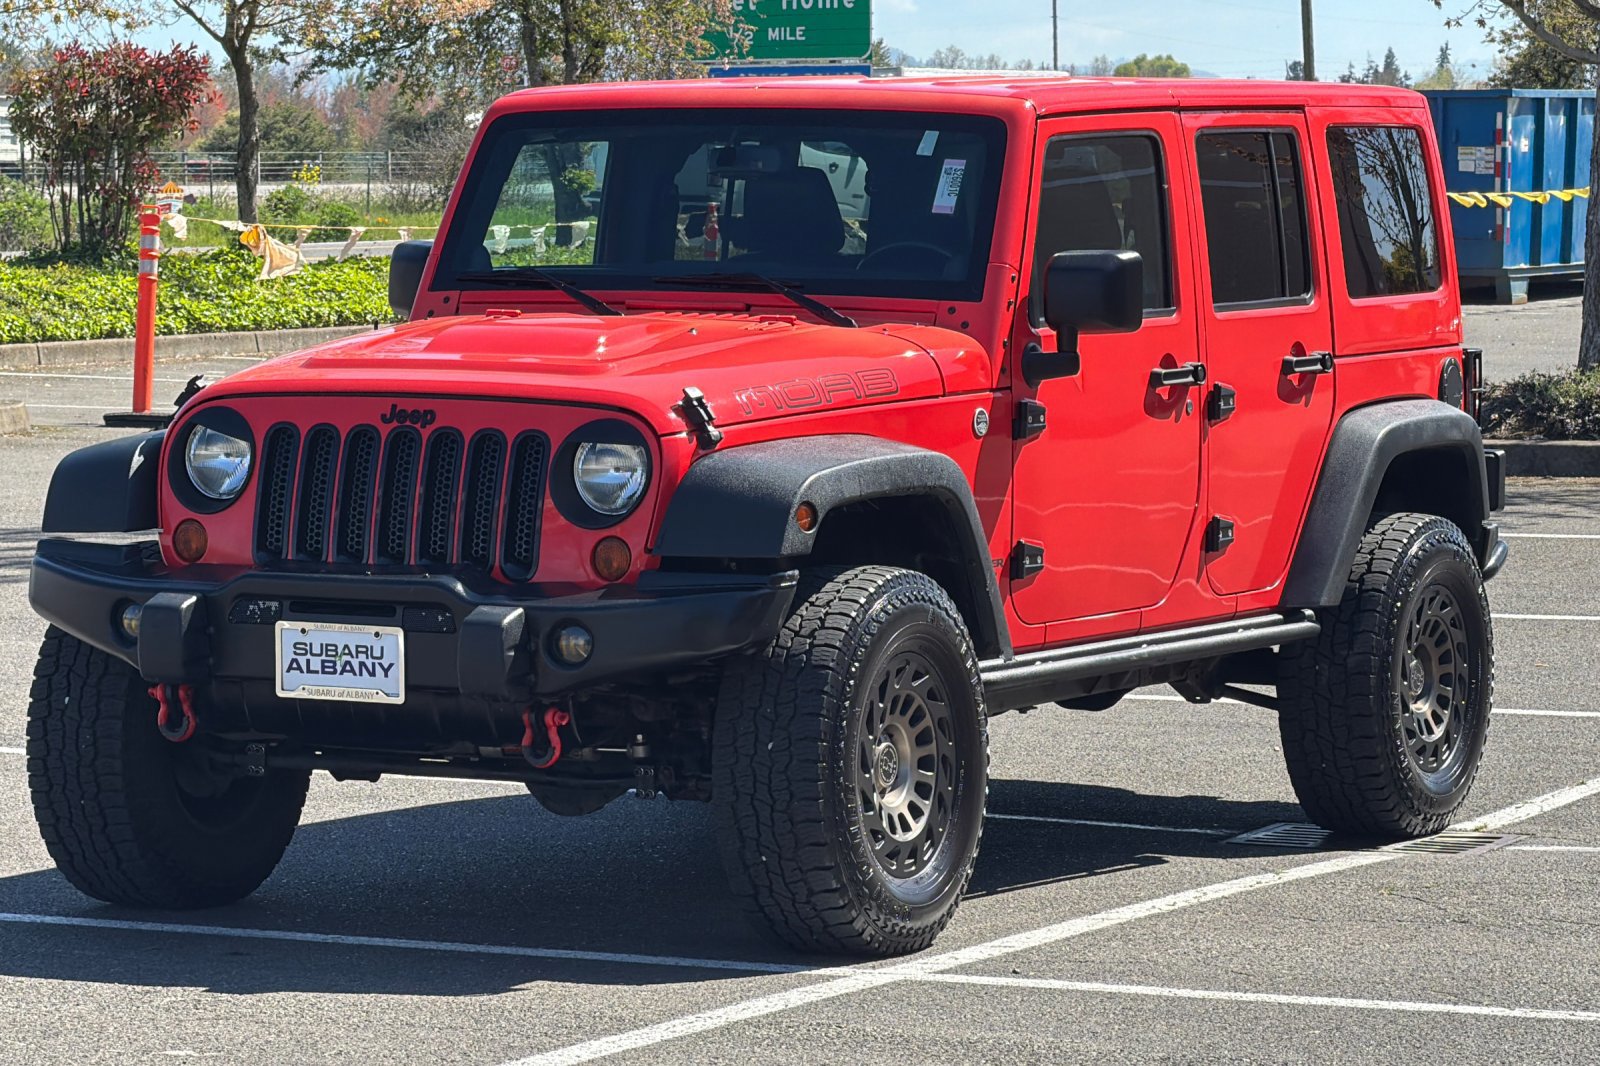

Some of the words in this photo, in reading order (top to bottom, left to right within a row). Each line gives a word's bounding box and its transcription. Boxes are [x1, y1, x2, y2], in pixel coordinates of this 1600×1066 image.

[767, 26, 806, 41] MILE
[734, 368, 899, 415] MOAB
[380, 403, 436, 429] Jeep
[292, 641, 385, 661] SUBARU
[285, 657, 396, 679] ALBANY
[306, 688, 336, 699] SUBARU
[337, 690, 346, 699] of
[345, 690, 375, 701] ALBANY
